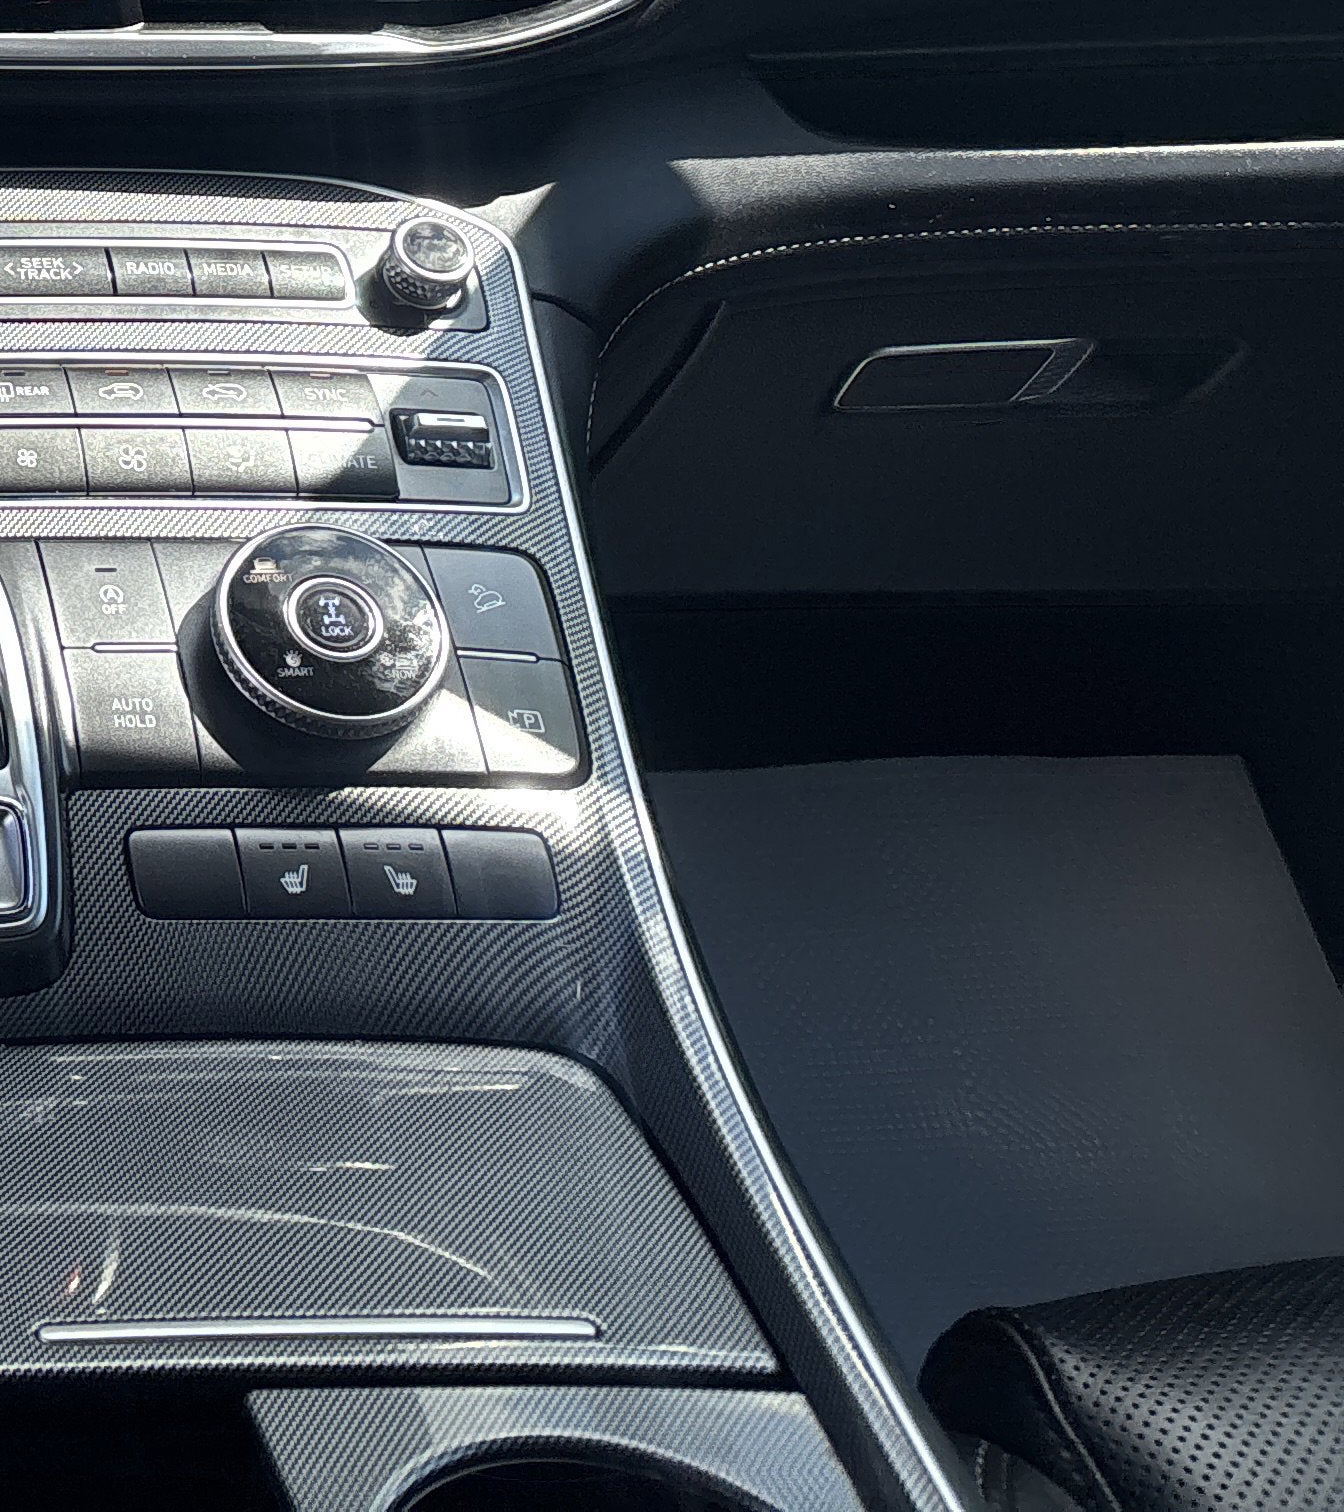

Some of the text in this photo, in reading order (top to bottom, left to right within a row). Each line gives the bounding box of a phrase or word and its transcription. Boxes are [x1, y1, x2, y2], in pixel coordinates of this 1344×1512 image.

[19, 257, 64, 270] SEEK
[125, 261, 176, 276] RADIO
[203, 262, 254, 277] MEDIA
[17, 267, 73, 281] TRACK
[15, 385, 50, 397] REAR
[302, 387, 347, 402] SYNC
[242, 574, 293, 584] COMFORT
[101, 603, 127, 615] OFF
[320, 625, 354, 637] LOCK
[277, 666, 314, 678] SMART
[111, 697, 154, 712] AUTO
[113, 714, 157, 728] HOLD
